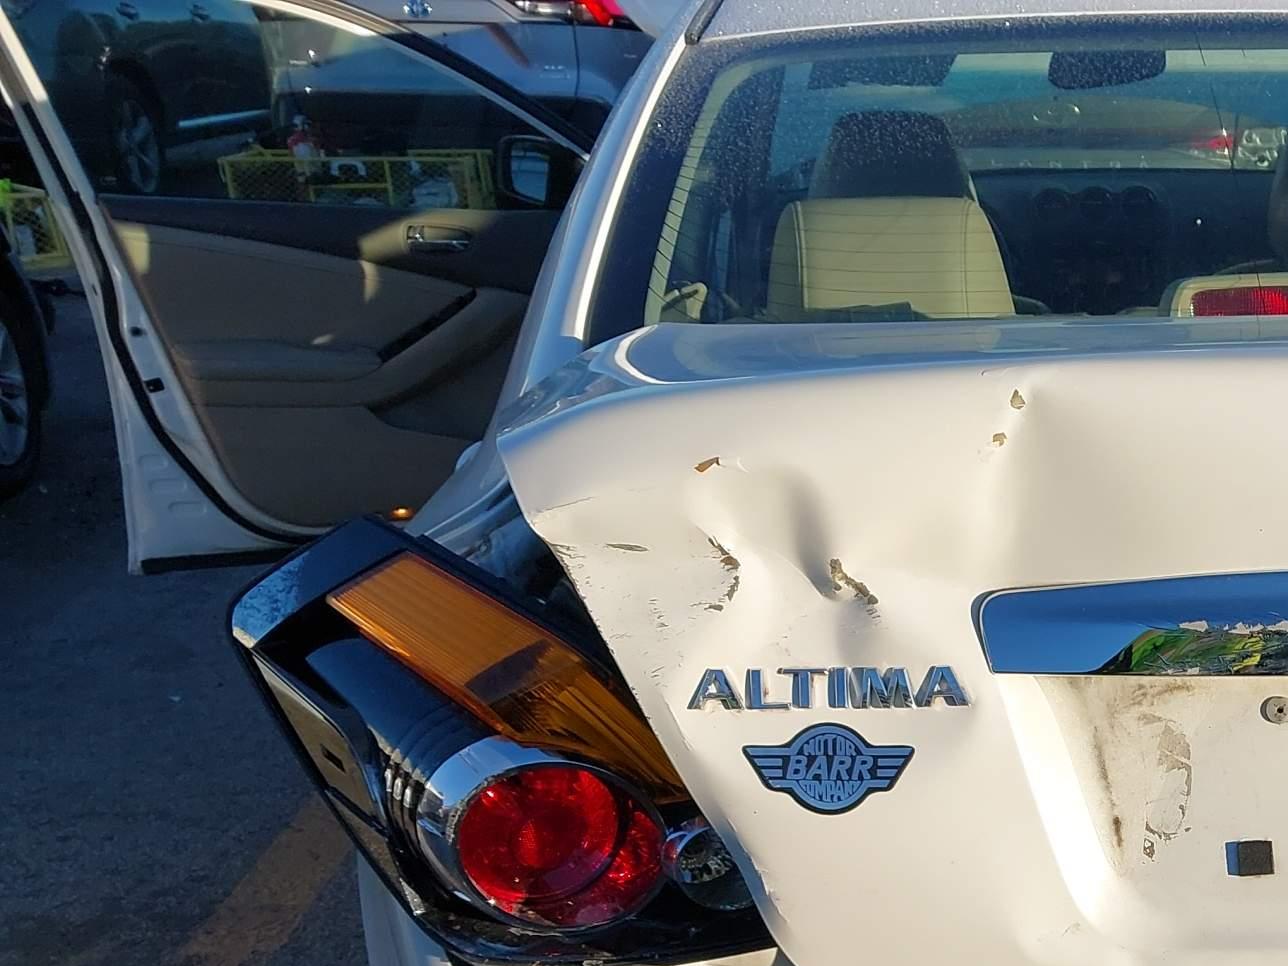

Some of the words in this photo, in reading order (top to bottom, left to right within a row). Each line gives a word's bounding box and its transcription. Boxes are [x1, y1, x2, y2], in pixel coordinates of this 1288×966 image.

[686, 665, 971, 710] ALTIMA
[803, 733, 857, 756] MOTOR
[786, 755, 873, 780] BARR
[798, 779, 862, 803] COMPANY
